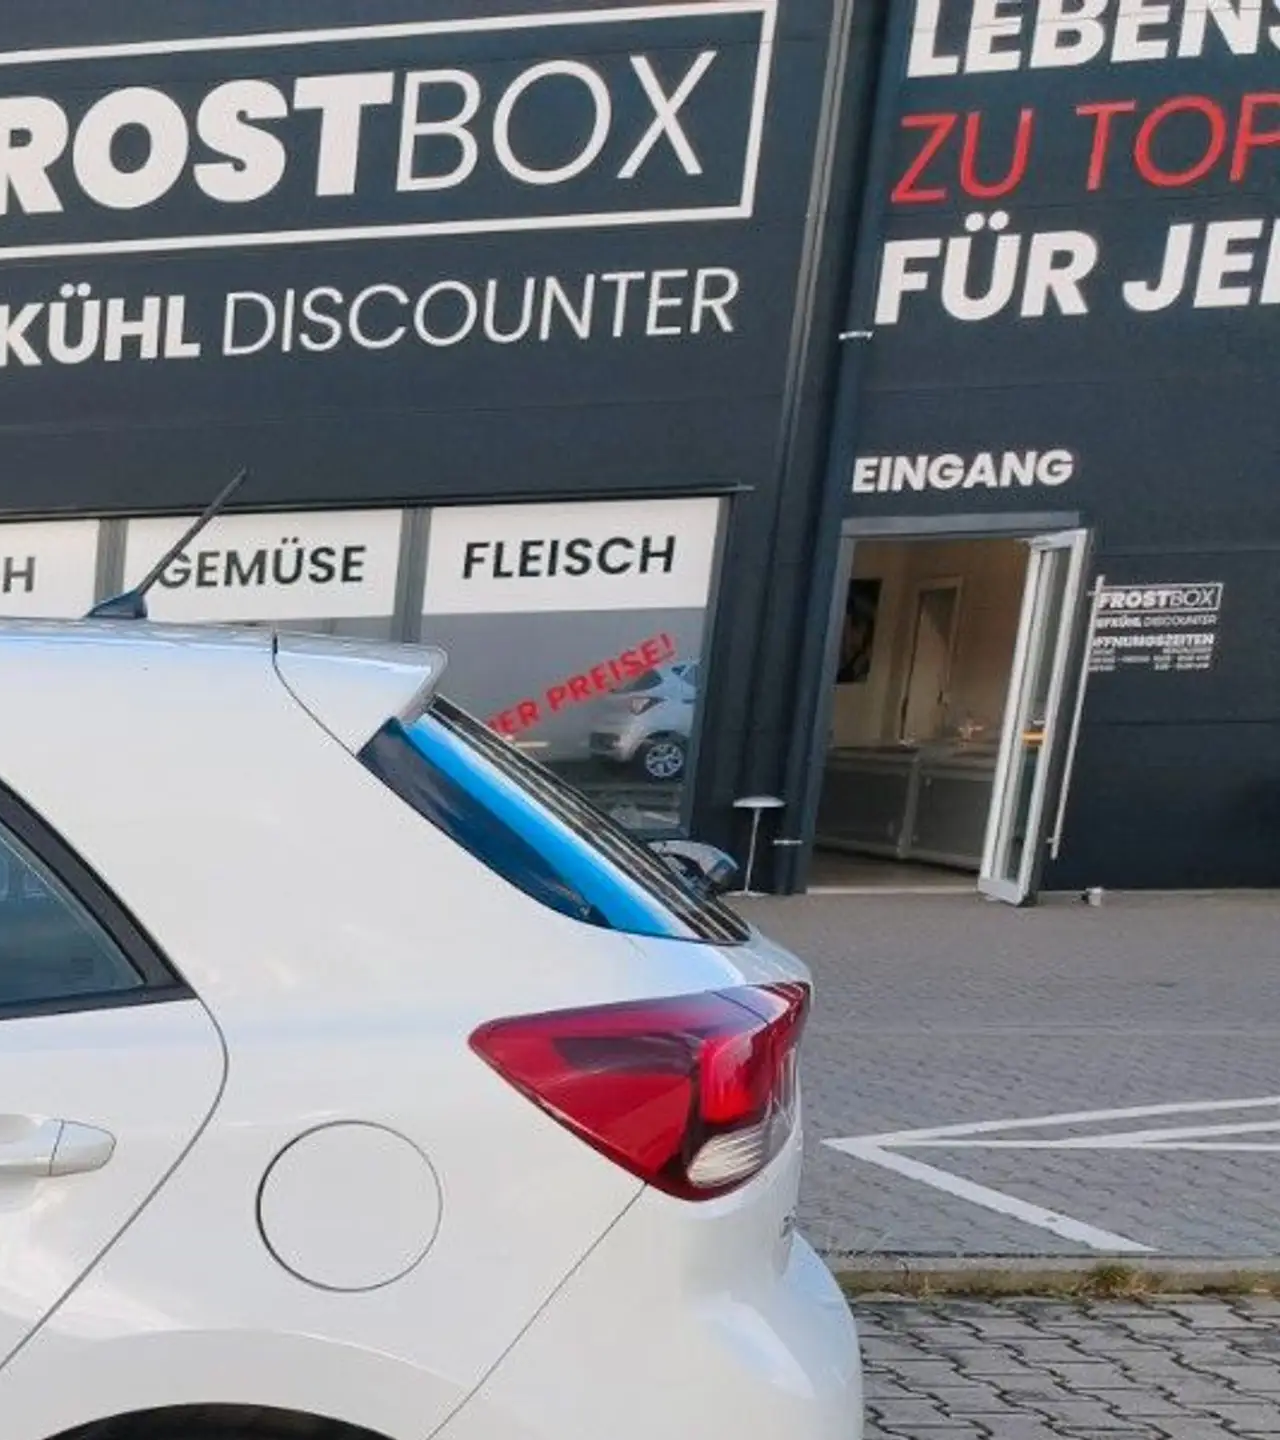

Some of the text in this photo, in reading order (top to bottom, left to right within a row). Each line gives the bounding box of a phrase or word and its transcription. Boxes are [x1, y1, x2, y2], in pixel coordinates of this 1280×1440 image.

[907, 0, 1280, 77] LEBEN
[890, 108, 1032, 203] ZU
[874, 211, 1280, 325] FÜR JE
[223, 267, 740, 356] DISCOUNTER
[852, 449, 1075, 493] EINGANG
[157, 537, 366, 589] GEMÜSE
[462, 535, 677, 580] FLEISCH
[546, 633, 676, 712] PREISE!
